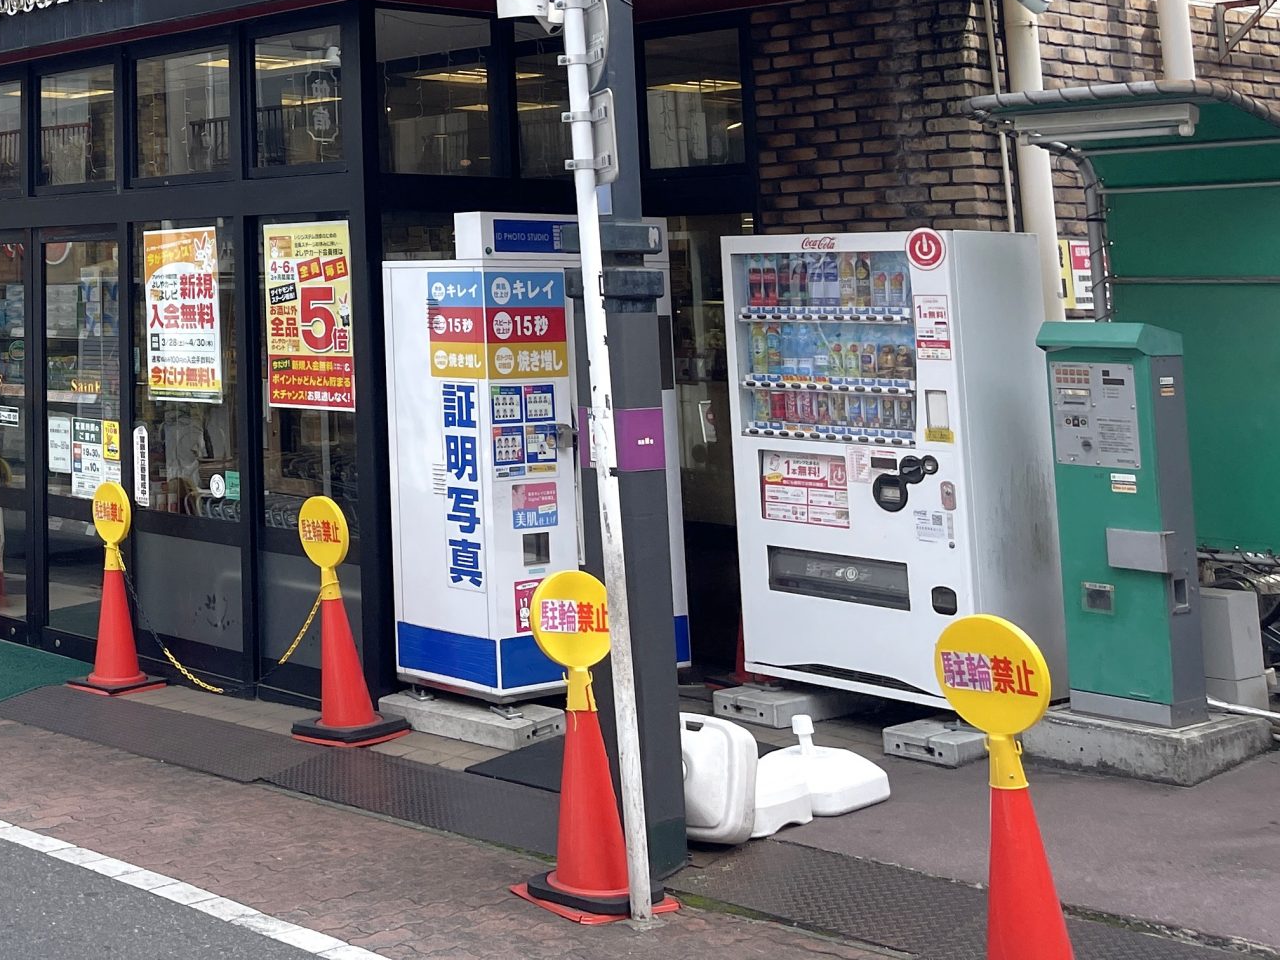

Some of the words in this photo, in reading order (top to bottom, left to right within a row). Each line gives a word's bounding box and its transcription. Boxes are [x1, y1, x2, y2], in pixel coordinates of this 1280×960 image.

[504, 232, 526, 241] PHOTO
[527, 233, 550, 242] STUDIO
[299, 261, 320, 279] 全員
[324, 261, 346, 278] 毎日
[179, 273, 214, 300] 新規
[446, 283, 478, 298] キレイ
[513, 280, 554, 300] キレイ
[150, 303, 215, 330] 入会無料
[300, 286, 336, 351] 5
[448, 318, 474, 333] 15秒
[514, 315, 549, 336] 15秒
[270, 317, 299, 338] 全品
[333, 327, 349, 352] 倍
[291, 359, 334, 371] 新規入会無料
[448, 352, 482, 368] 焼き増し
[517, 350, 563, 372] 焼き増し
[71, 379, 101, 395] SainE
[151, 366, 216, 387] 今だけ無料!
[272, 373, 351, 388] ポイントがどんどん貯まる
[442, 383, 483, 588] 証明写真
[300, 519, 342, 544] 駐輪禁止
[541, 600, 609, 633] 駐輪禁止
[940, 650, 1039, 697] 駐輪禁止
